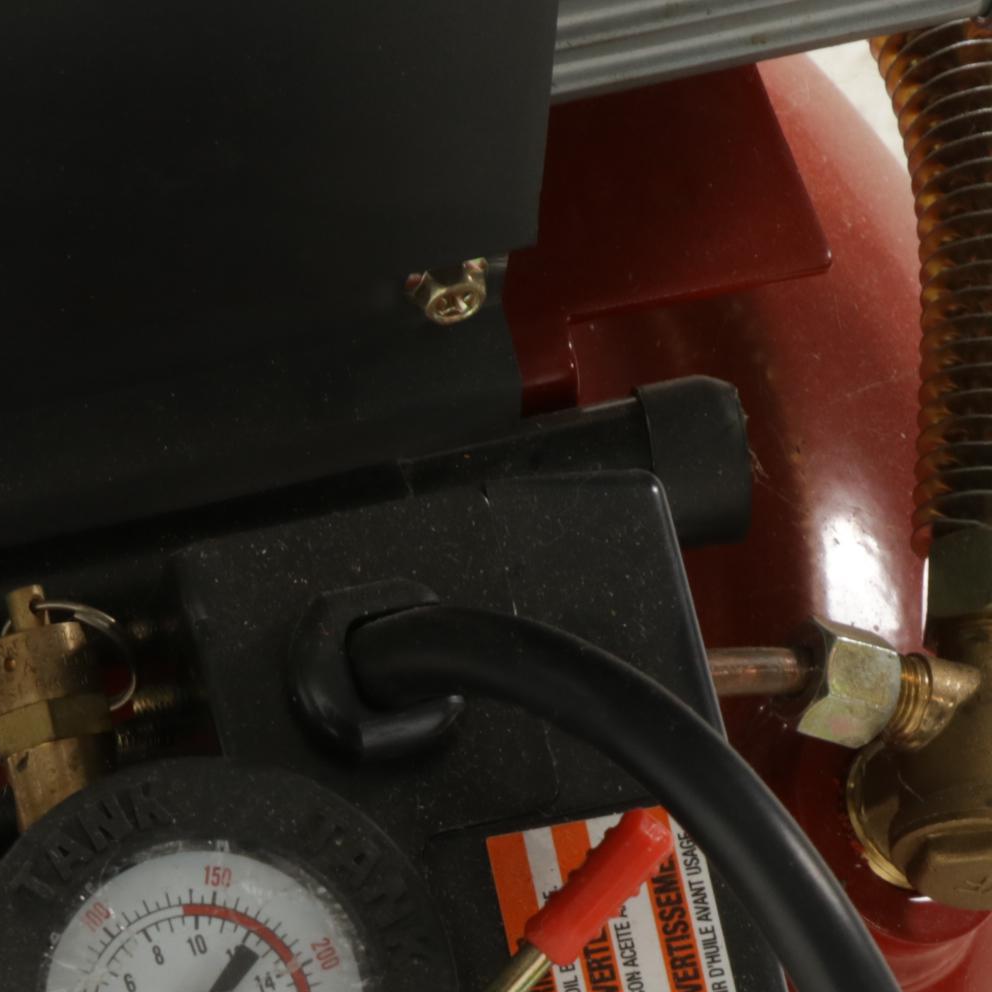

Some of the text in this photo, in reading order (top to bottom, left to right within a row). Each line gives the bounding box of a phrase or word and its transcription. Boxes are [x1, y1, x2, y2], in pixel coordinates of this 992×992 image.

[203, 865, 232, 890] 150
[693, 881, 716, 922] AVANT
[152, 945, 165, 967] 8
[186, 935, 208, 956] 10
[310, 936, 342, 973] 200
[614, 919, 640, 970] ACEITE
[702, 926, 729, 980] D'HUILE
